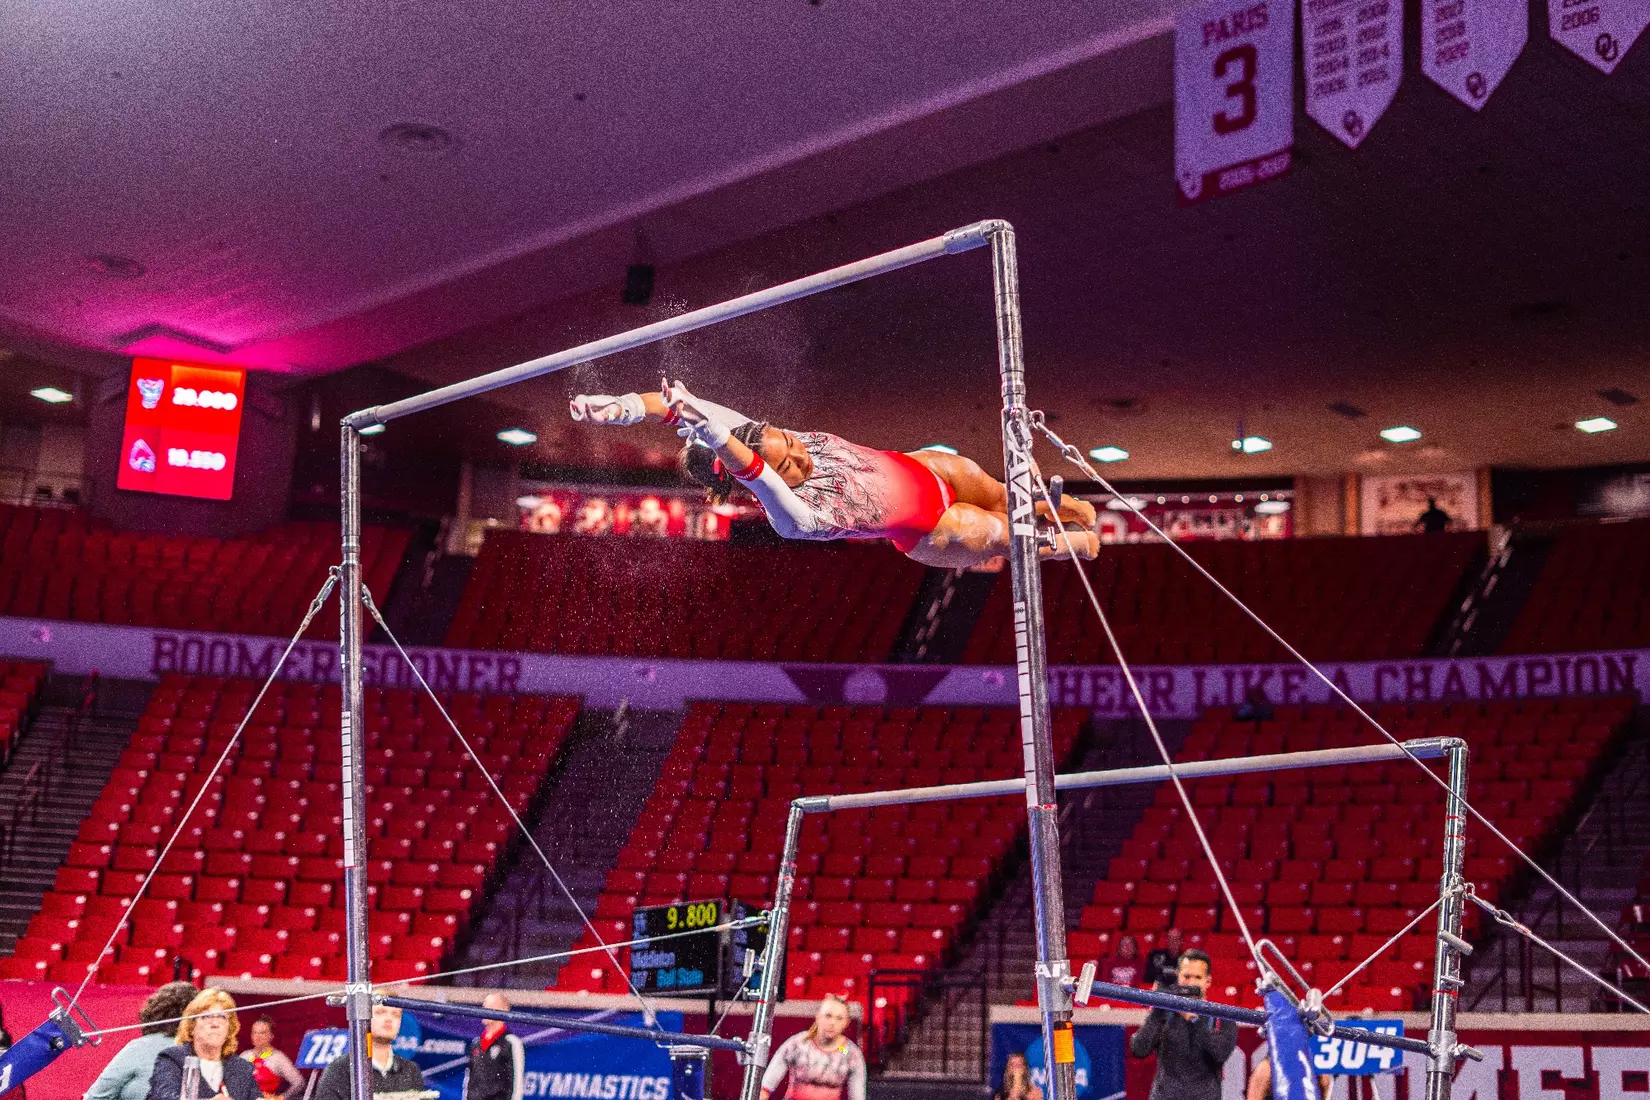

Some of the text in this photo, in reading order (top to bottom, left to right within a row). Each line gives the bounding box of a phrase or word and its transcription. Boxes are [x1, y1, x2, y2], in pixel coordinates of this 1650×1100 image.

[1203, 2, 1269, 46] PARIS
[1561, 6, 1600, 31] 2006
[1212, 42, 1257, 136] 3
[152, 635, 521, 691] BOOMER SOONER
[1045, 656, 1637, 711] HEER LIKE A CHAMPION
[667, 902, 717, 930] 9.800
[304, 1034, 348, 1064] 713
[1314, 1027, 1397, 1069] 304
[524, 1071, 670, 1100] GYMNASTICS
[1031, 1067, 1088, 1087] NA
